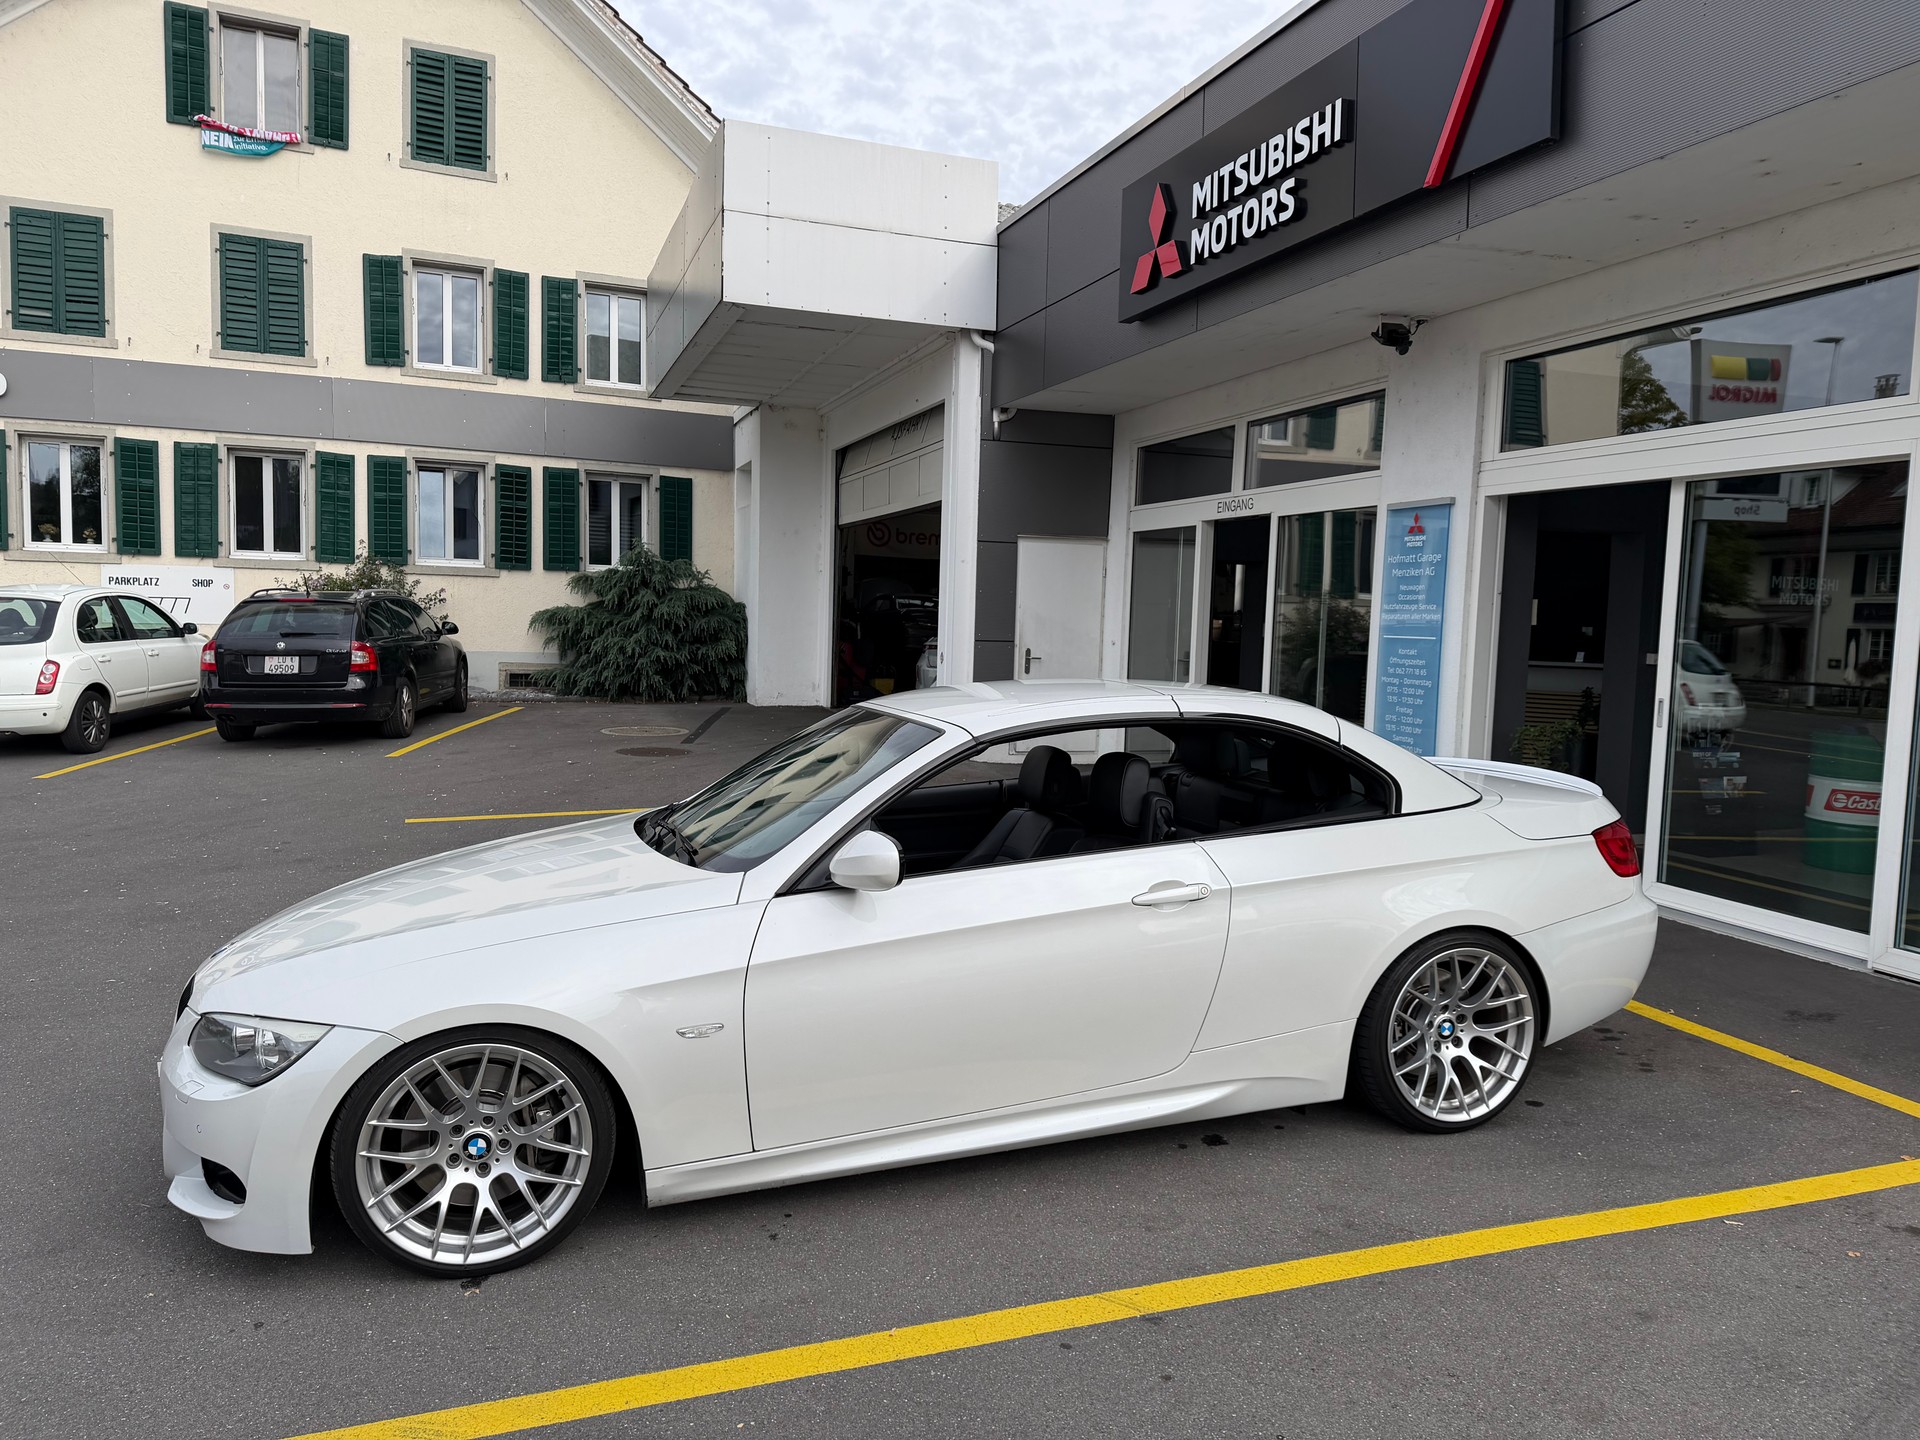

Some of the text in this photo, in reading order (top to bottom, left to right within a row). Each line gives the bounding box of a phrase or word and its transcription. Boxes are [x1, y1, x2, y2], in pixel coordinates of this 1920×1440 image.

[202, 130, 234, 149] NEIN
[1192, 97, 1343, 219] MITSUBISHI
[1190, 177, 1296, 265] MOTORS
[1217, 497, 1254, 513] EINGANG
[1388, 553, 1442, 564] Hofmatt Garage
[1392, 567, 1435, 577] Menziken AG
[108, 576, 214, 588] PARKPLATZ SHOP
[1771, 576, 1840, 592] MITSUBISHI
[1779, 593, 1830, 606] MOTORS
[1398, 648, 1418, 656] Kontakt
[277, 656, 287, 664] LU
[268, 664, 295, 674] 49509
[1381, 676, 1399, 685] Montag
[1395, 706, 1413, 715] Freitag
[1392, 735, 1414, 744] Samstag
